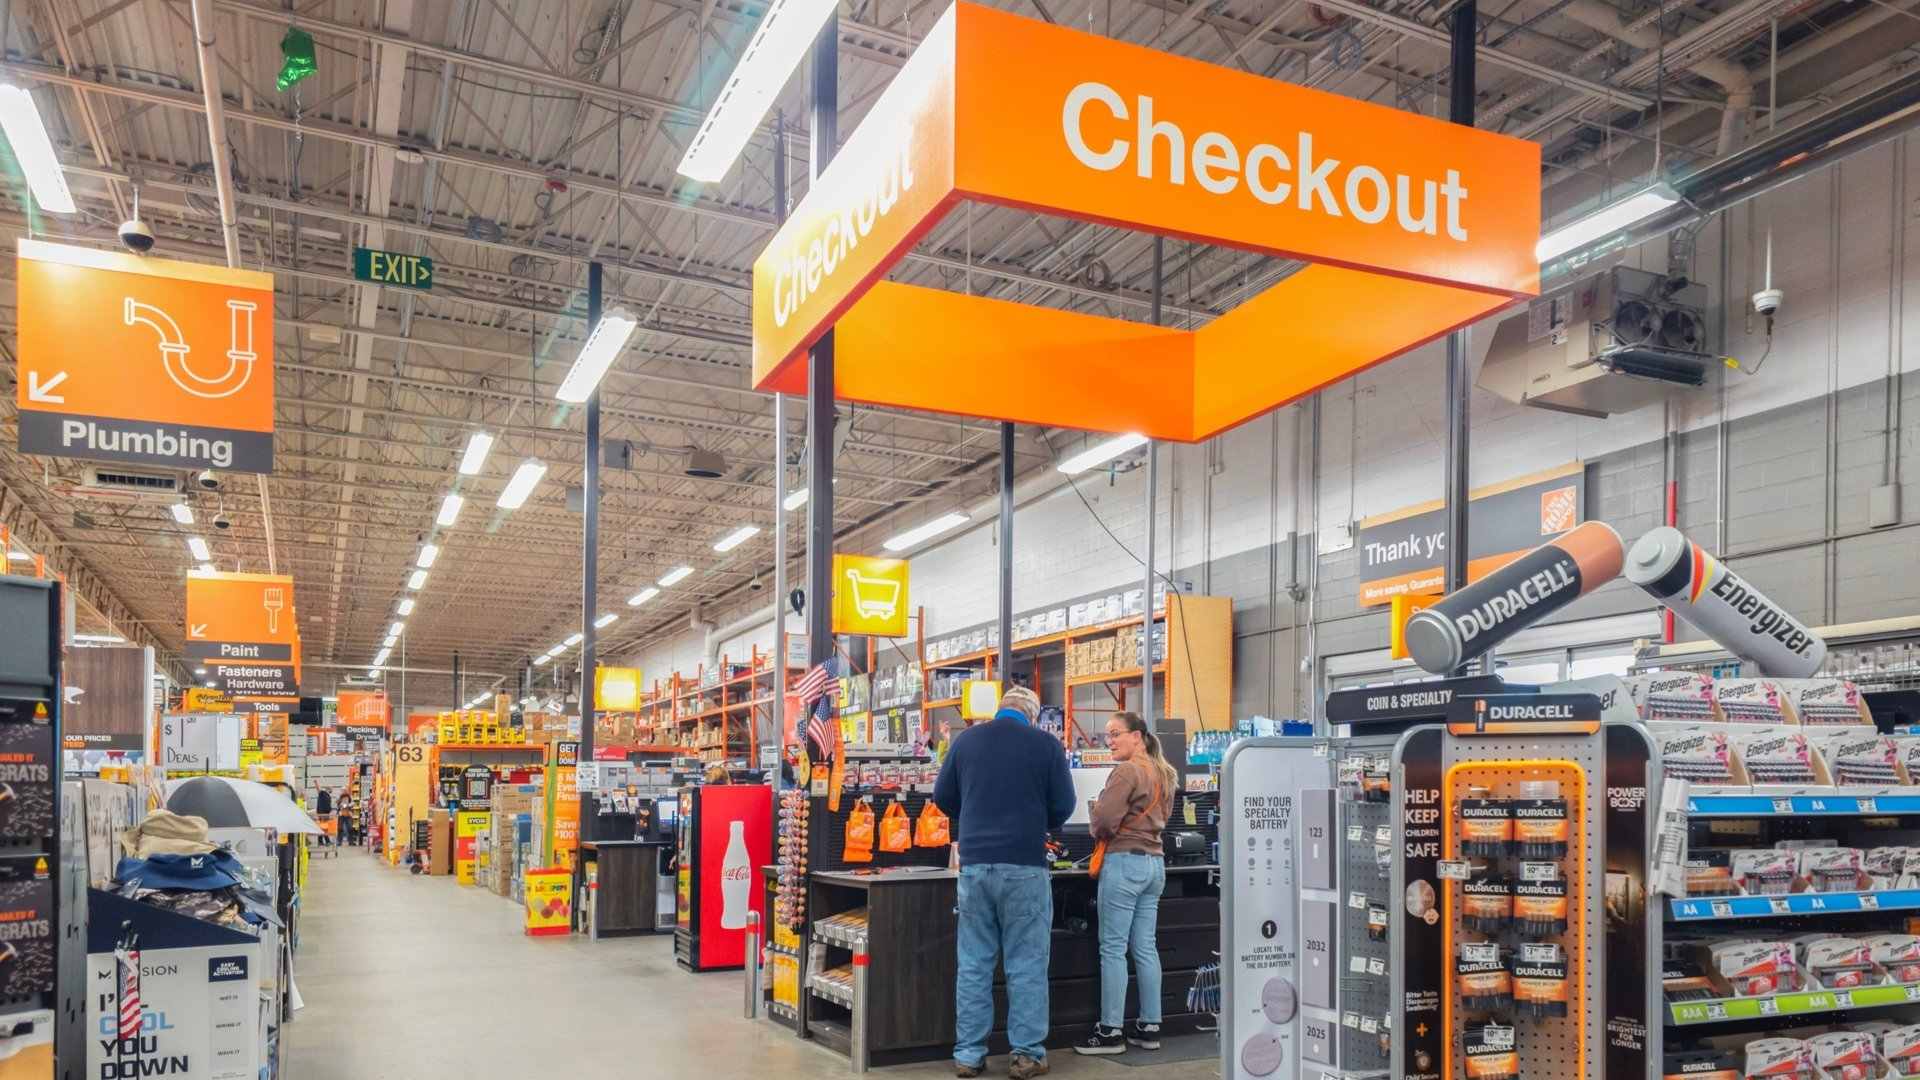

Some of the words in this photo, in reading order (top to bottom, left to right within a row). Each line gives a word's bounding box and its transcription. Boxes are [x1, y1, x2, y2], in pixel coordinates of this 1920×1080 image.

[1062, 81, 1469, 241] Checkout
[773, 120, 915, 328] Checkout
[371, 252, 420, 285] EXIT
[62, 420, 233, 467] Plumbing
[1365, 534, 1420, 565] Thank
[1426, 532, 1445, 559] yo
[1456, 560, 1575, 642] DURACELL
[1711, 571, 1814, 655] Energizer
[221, 644, 259, 656] Paint
[217, 665, 282, 677] Fasteners
[227, 679, 284, 689] Hardware
[1649, 676, 1692, 693] Energizer
[1719, 682, 1756, 699] Energizer
[1801, 684, 1838, 701] Energizer
[253, 702, 280, 711] Tools
[1367, 696, 1389, 711] COIN
[1391, 695, 1399, 708] &
[1400, 690, 1453, 707] SPECIALTY
[1490, 705, 1574, 719] DURACELL
[559, 743, 577, 753] GET
[1663, 736, 1706, 756] Energizer
[1746, 737, 1787, 758] Energizer
[1837, 740, 1879, 758] Energizer
[399, 746, 423, 762] 63
[1405, 789, 1440, 804] HELP
[1608, 787, 1647, 798] POWER
[1244, 796, 1264, 807] FIND
[1267, 796, 1291, 807] YOUR
[1611, 797, 1642, 808] BOOST
[1812, 800, 1825, 811] AA
[1245, 807, 1290, 818] SPECIALTY
[1405, 809, 1440, 823] KEEP
[1463, 808, 1509, 817] DURACELL
[1516, 808, 1564, 817] DURACELL
[1250, 819, 1287, 829] BATTERY
[1309, 827, 1323, 838] 123
[1405, 829, 1439, 838] CHILDREN
[1406, 843, 1439, 858] SAFE
[1464, 884, 1509, 893] DURACELL
[1517, 885, 1563, 894] DURACELL
[1684, 904, 1698, 915] AA
[1812, 898, 1825, 909] AA
[1306, 939, 1326, 952] 2032
[1241, 954, 1264, 962] BATTERY
[98, 965, 178, 980] MSION
[1459, 961, 1505, 973] DURACELL
[1515, 967, 1563, 977] DURACELL
[1809, 996, 1828, 1007] AAA
[1681, 1008, 1703, 1019] AAA
[100, 1012, 175, 1035] COL
[1306, 1026, 1326, 1040] 2025
[1608, 1024, 1647, 1038] BRIGHTEST
[1619, 1033, 1633, 1041] FOR
[101, 1036, 157, 1057] YOU
[1467, 1043, 1513, 1054] DURACELL
[1611, 1038, 1642, 1050] LONGER
[101, 1056, 188, 1080] DOWN
[1682, 1062, 1716, 1073] DURACELL
